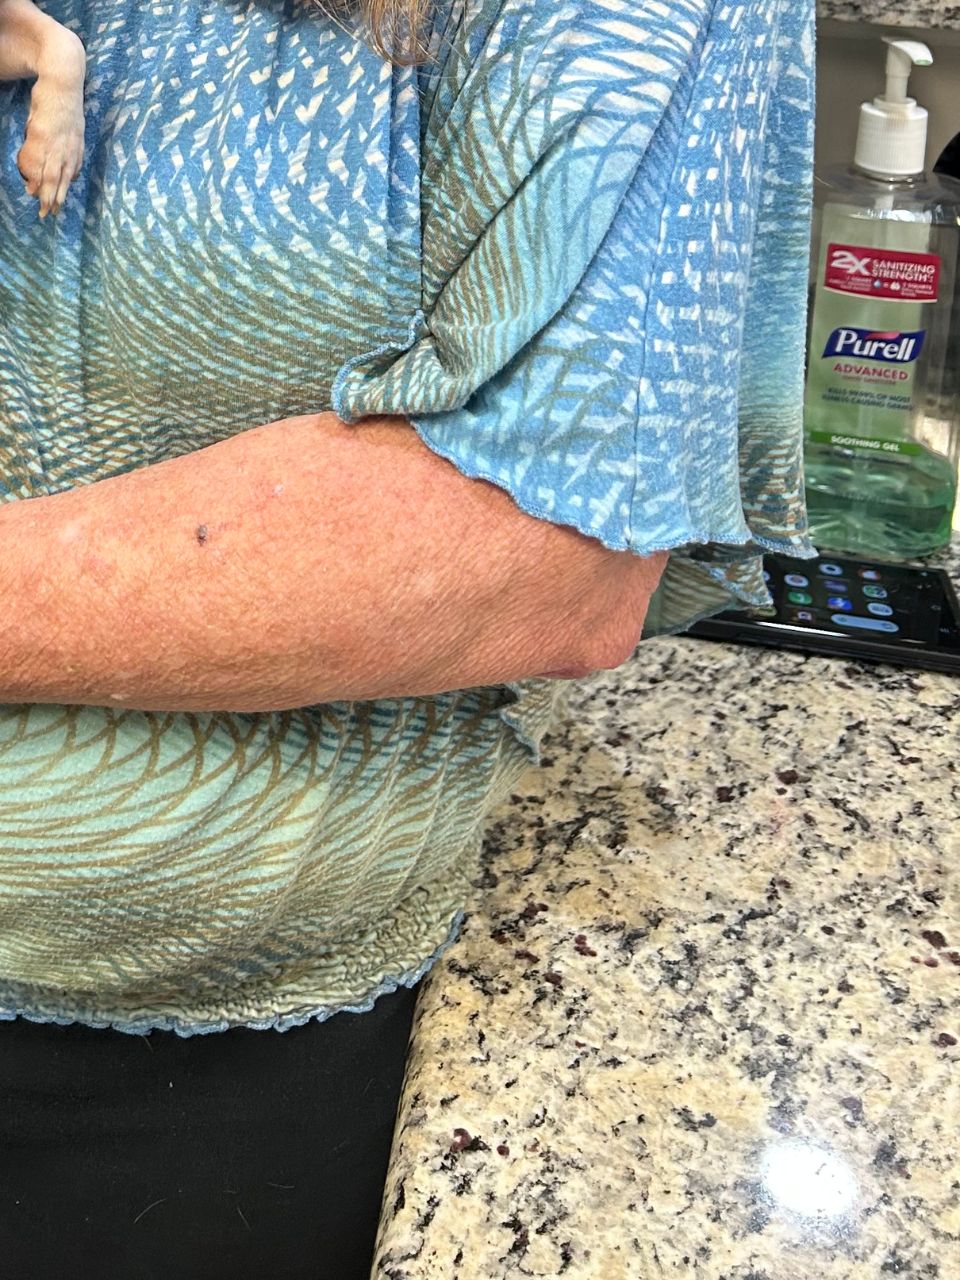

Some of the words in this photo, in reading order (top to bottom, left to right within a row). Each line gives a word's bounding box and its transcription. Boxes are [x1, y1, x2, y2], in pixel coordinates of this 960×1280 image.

[831, 250, 872, 277] 2X
[872, 259, 936, 275] SANITIZING
[835, 329, 916, 361] Purell
[832, 362, 908, 381] ADVANCED
[830, 434, 880, 450] SOOTHING
[882, 439, 900, 452] GEL
